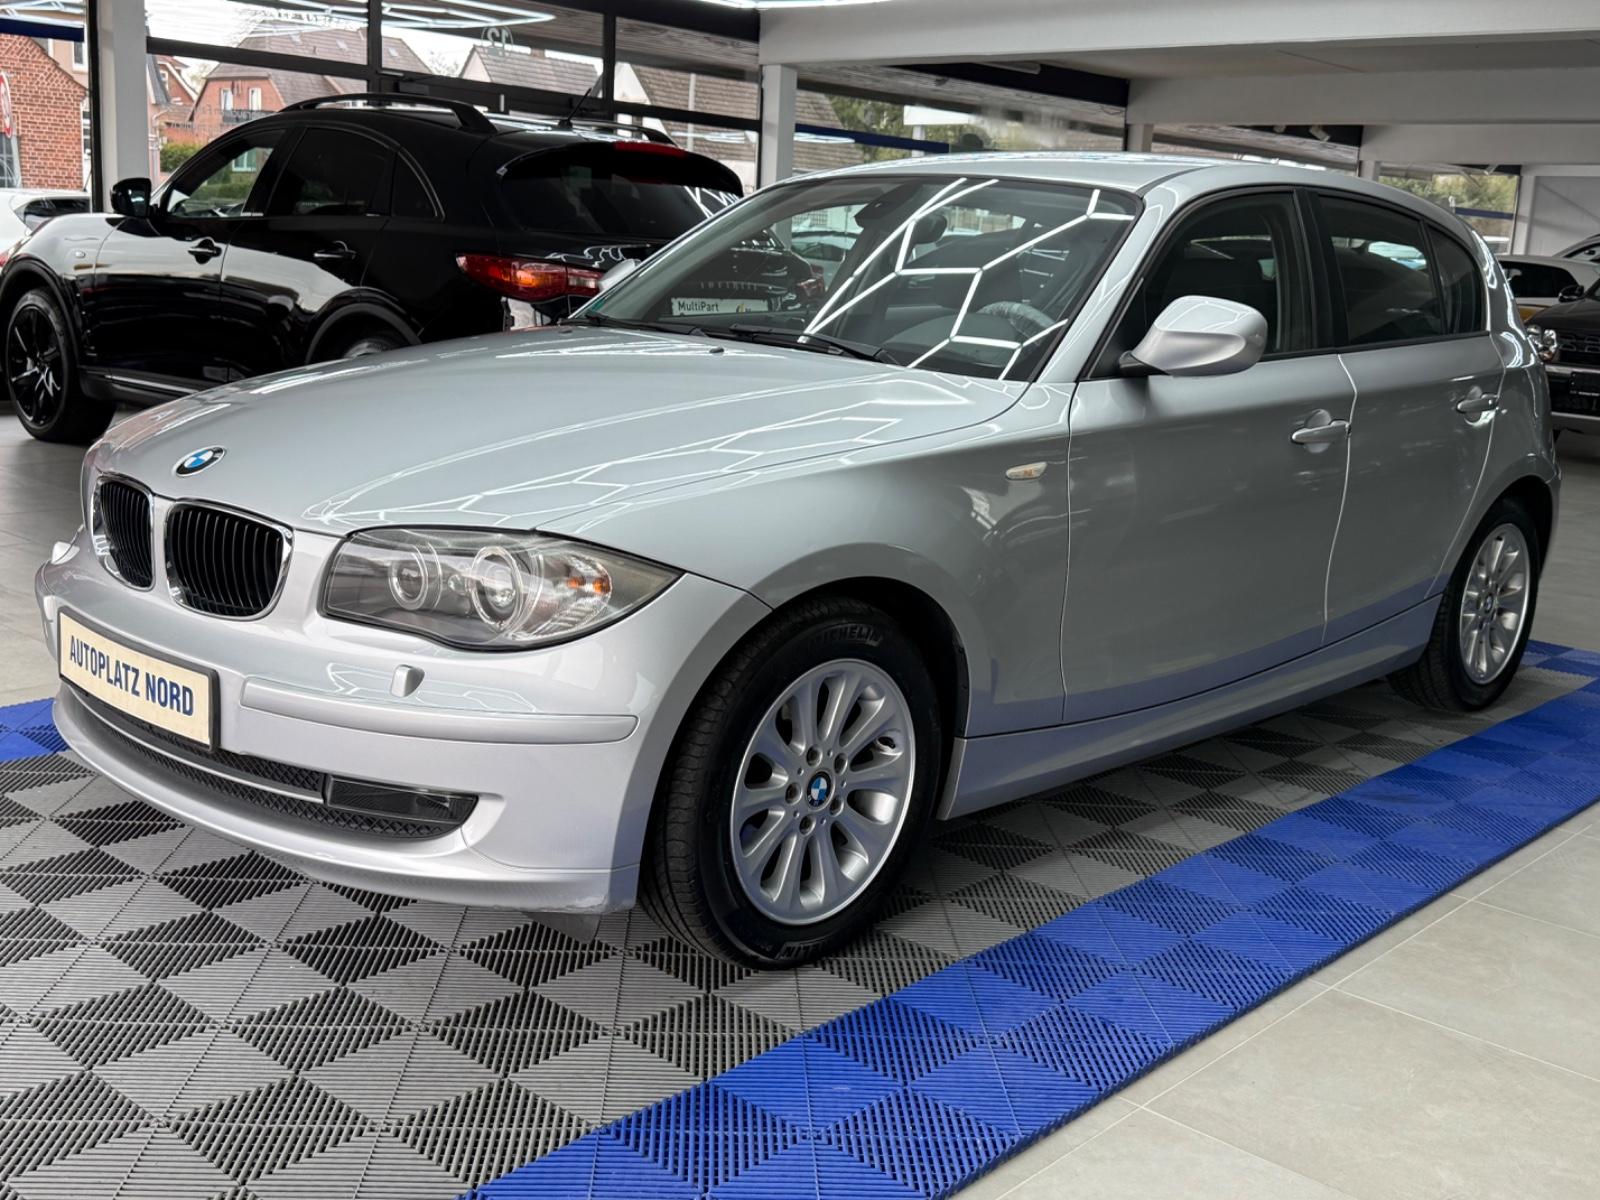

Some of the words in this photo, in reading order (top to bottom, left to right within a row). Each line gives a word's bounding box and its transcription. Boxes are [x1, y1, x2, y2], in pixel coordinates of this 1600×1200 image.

[678, 301, 719, 312] MultiPart
[70, 635, 140, 697] AUTOPLATZ
[145, 672, 193, 717] NORD
